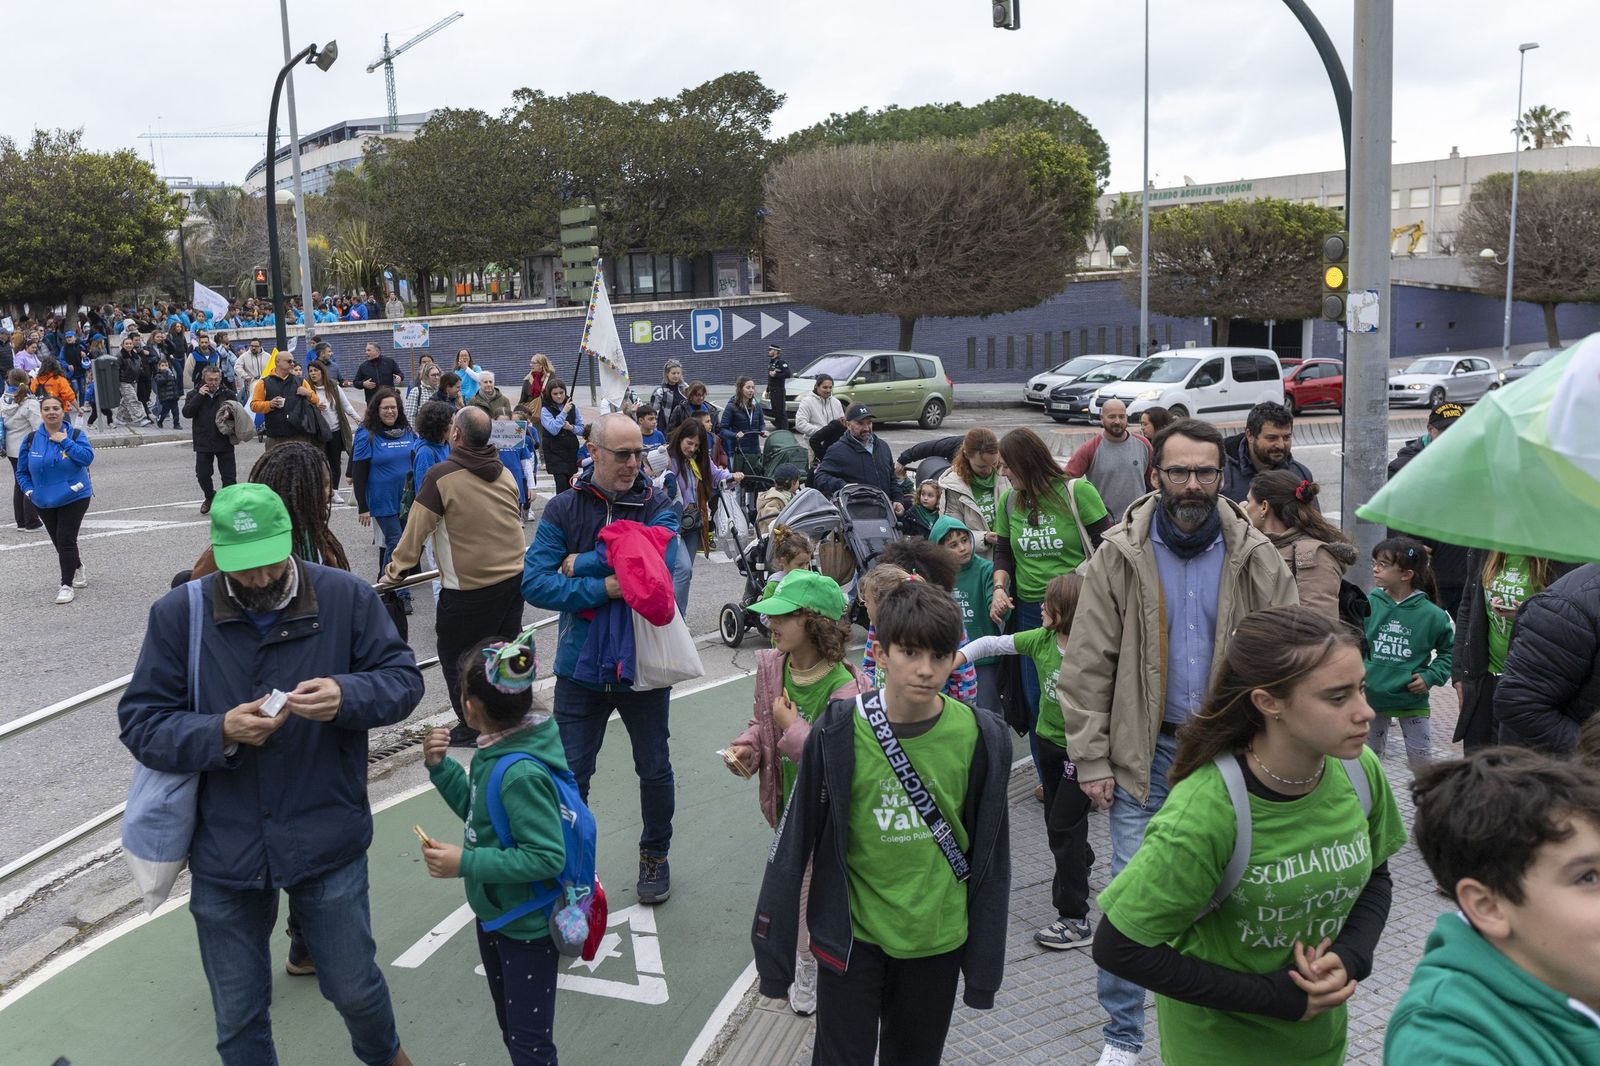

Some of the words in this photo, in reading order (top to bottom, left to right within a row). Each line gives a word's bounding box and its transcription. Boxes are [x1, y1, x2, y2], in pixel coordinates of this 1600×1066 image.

[1141, 191, 1178, 201] RNANDO
[1180, 186, 1213, 198] AGUILAR
[629, 319, 685, 343] iPark
[695, 313, 720, 346] P
[1022, 525, 1057, 537] María
[1017, 536, 1064, 551] Valle
[1378, 632, 1409, 646] María
[1373, 640, 1412, 657] Valle
[873, 805, 927, 831] Val
[881, 835, 912, 843] Colegio
[1241, 849, 1322, 885] SCUELA
[1321, 836, 1370, 873] PÚBLIC
[1257, 904, 1294, 922] DE
